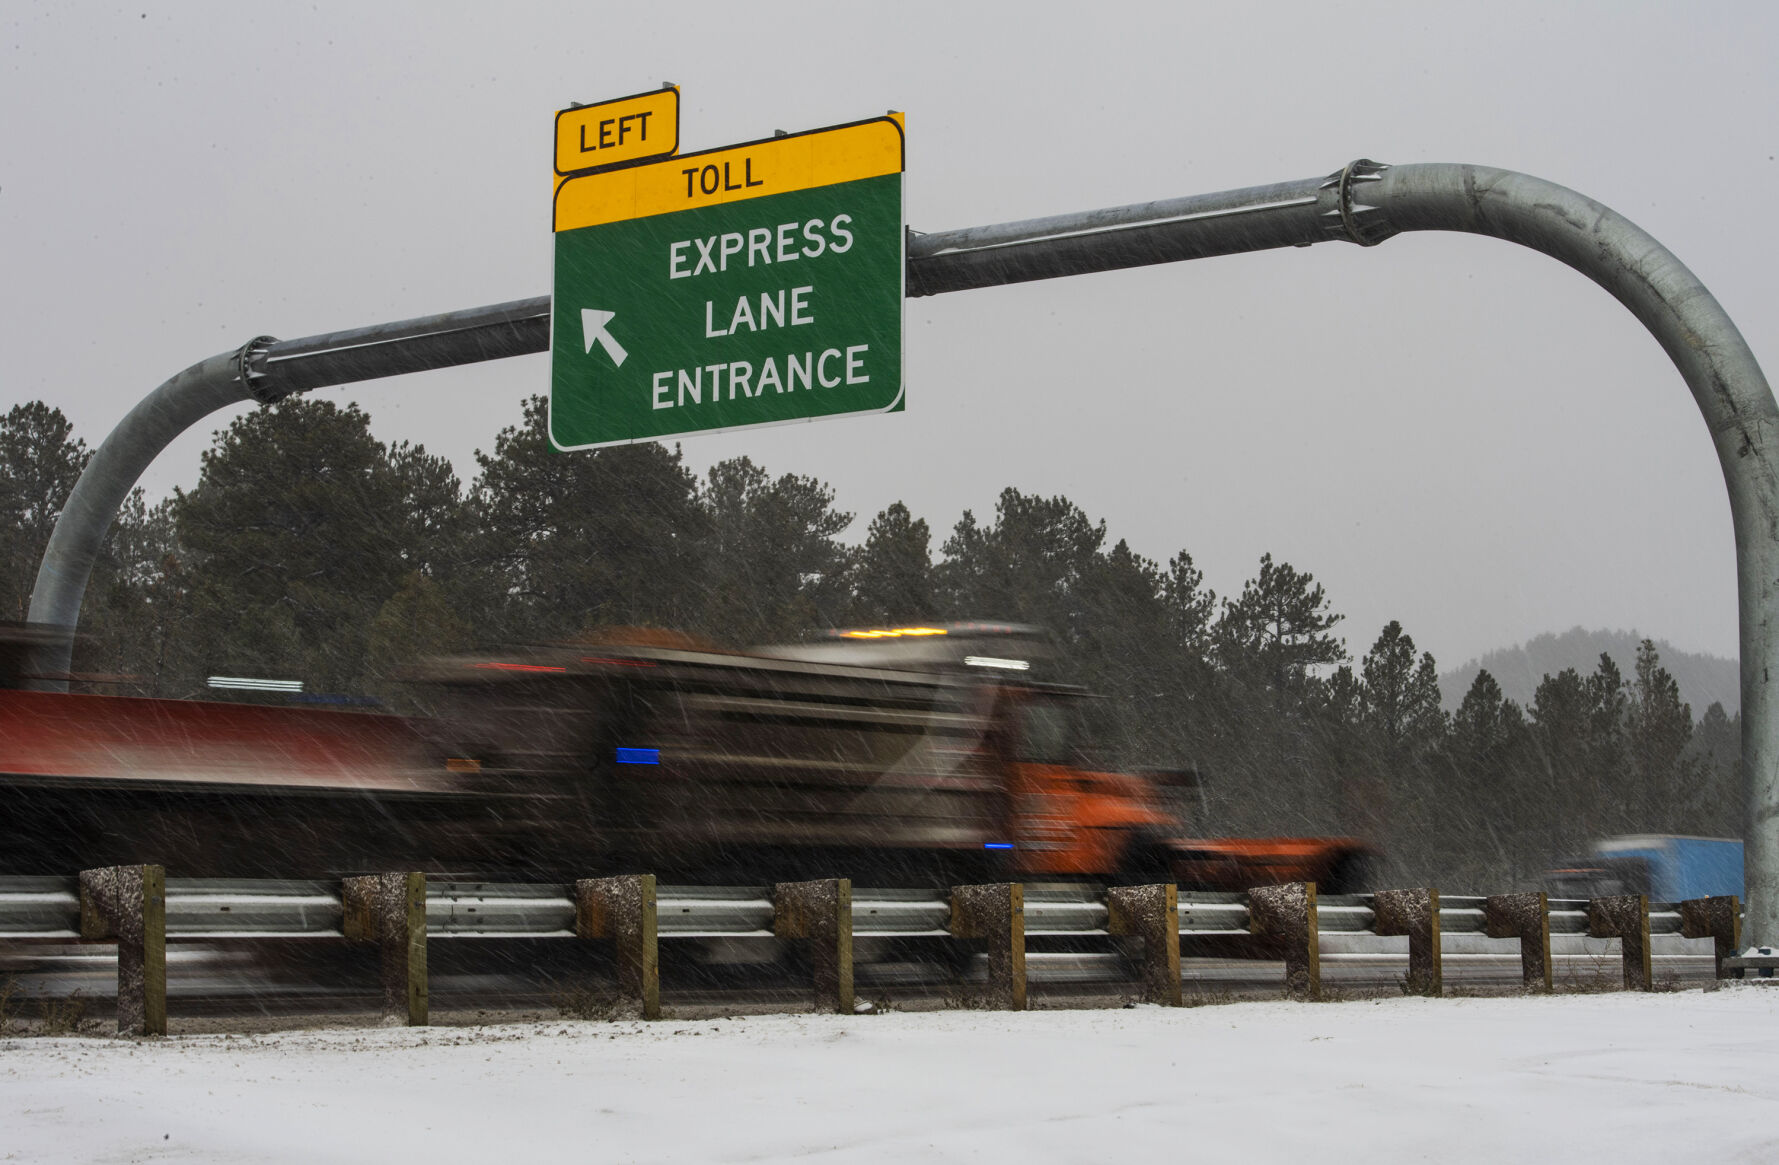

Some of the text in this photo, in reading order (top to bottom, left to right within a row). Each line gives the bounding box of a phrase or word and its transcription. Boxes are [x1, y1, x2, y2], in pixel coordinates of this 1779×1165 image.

[580, 111, 652, 153] LEFT
[682, 158, 763, 198] TOLL
[669, 214, 853, 279] EXPRESS
[705, 285, 814, 338] LANE
[652, 344, 869, 410] ENTRANCE
